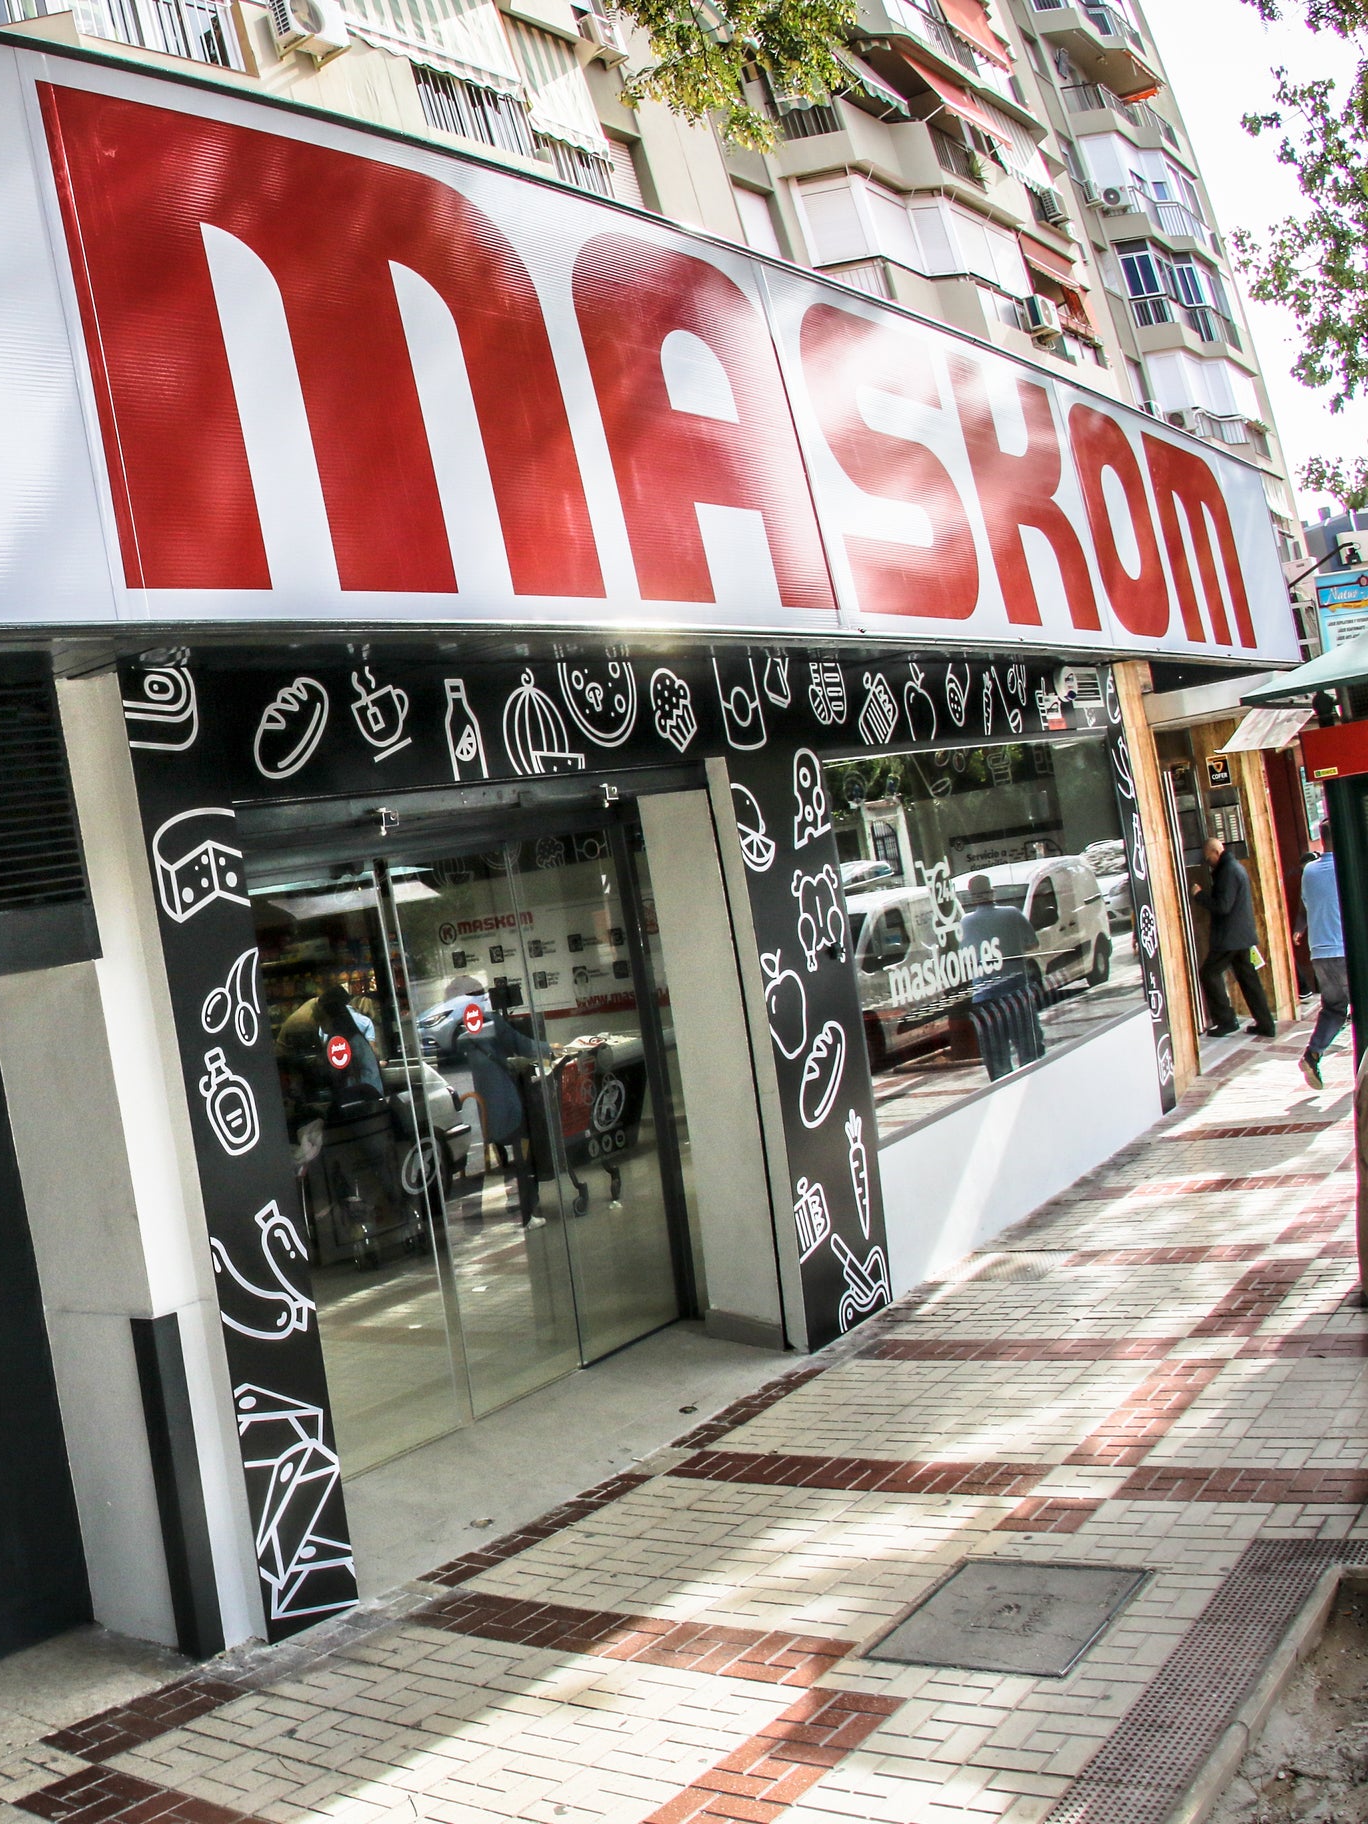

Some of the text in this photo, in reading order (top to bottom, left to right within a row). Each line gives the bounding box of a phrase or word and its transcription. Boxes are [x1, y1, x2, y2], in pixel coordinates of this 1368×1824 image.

[36, 81, 1258, 649] MASKOM
[966, 848, 999, 863] Servicio
[457, 911, 534, 935] MASKOM
[888, 936, 1003, 1007] maskom.es
